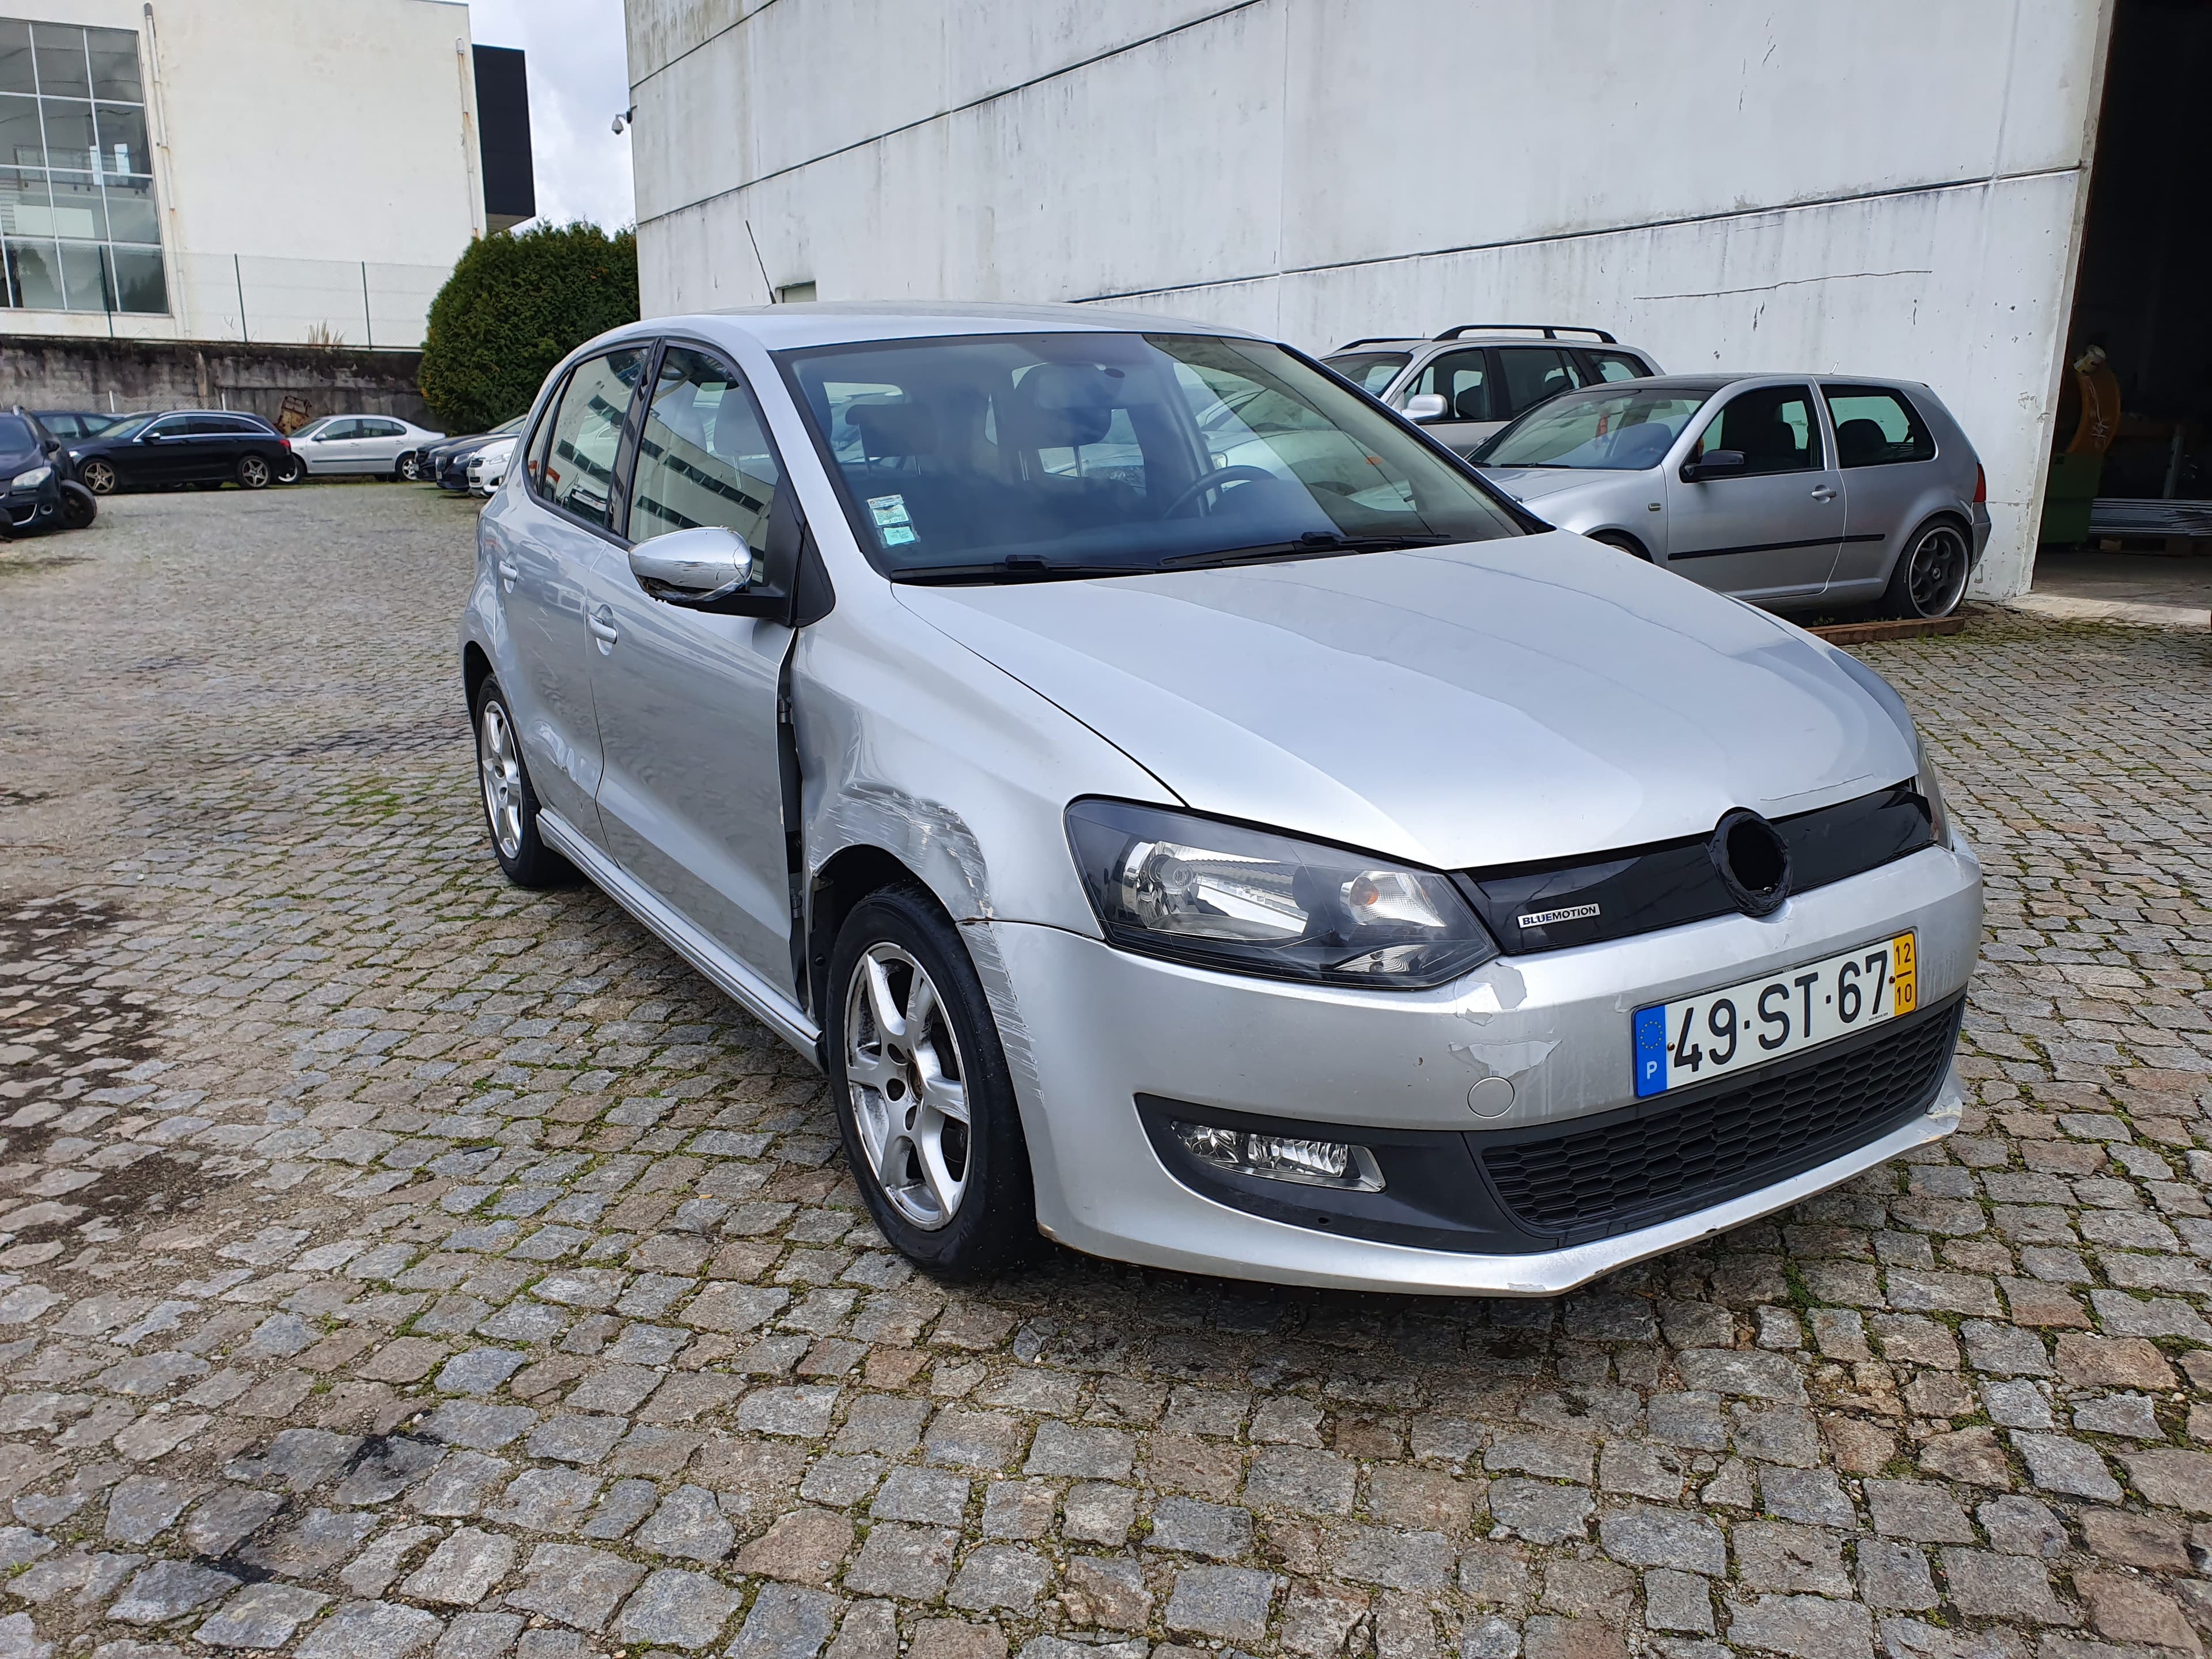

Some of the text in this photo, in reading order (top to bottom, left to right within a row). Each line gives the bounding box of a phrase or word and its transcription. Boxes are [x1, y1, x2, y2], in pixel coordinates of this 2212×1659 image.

[1522, 906, 1596, 926] BLUEMOTION
[1895, 942, 1912, 966] 12
[1896, 983, 1912, 1006] 10
[1646, 1060, 1658, 1080] P
